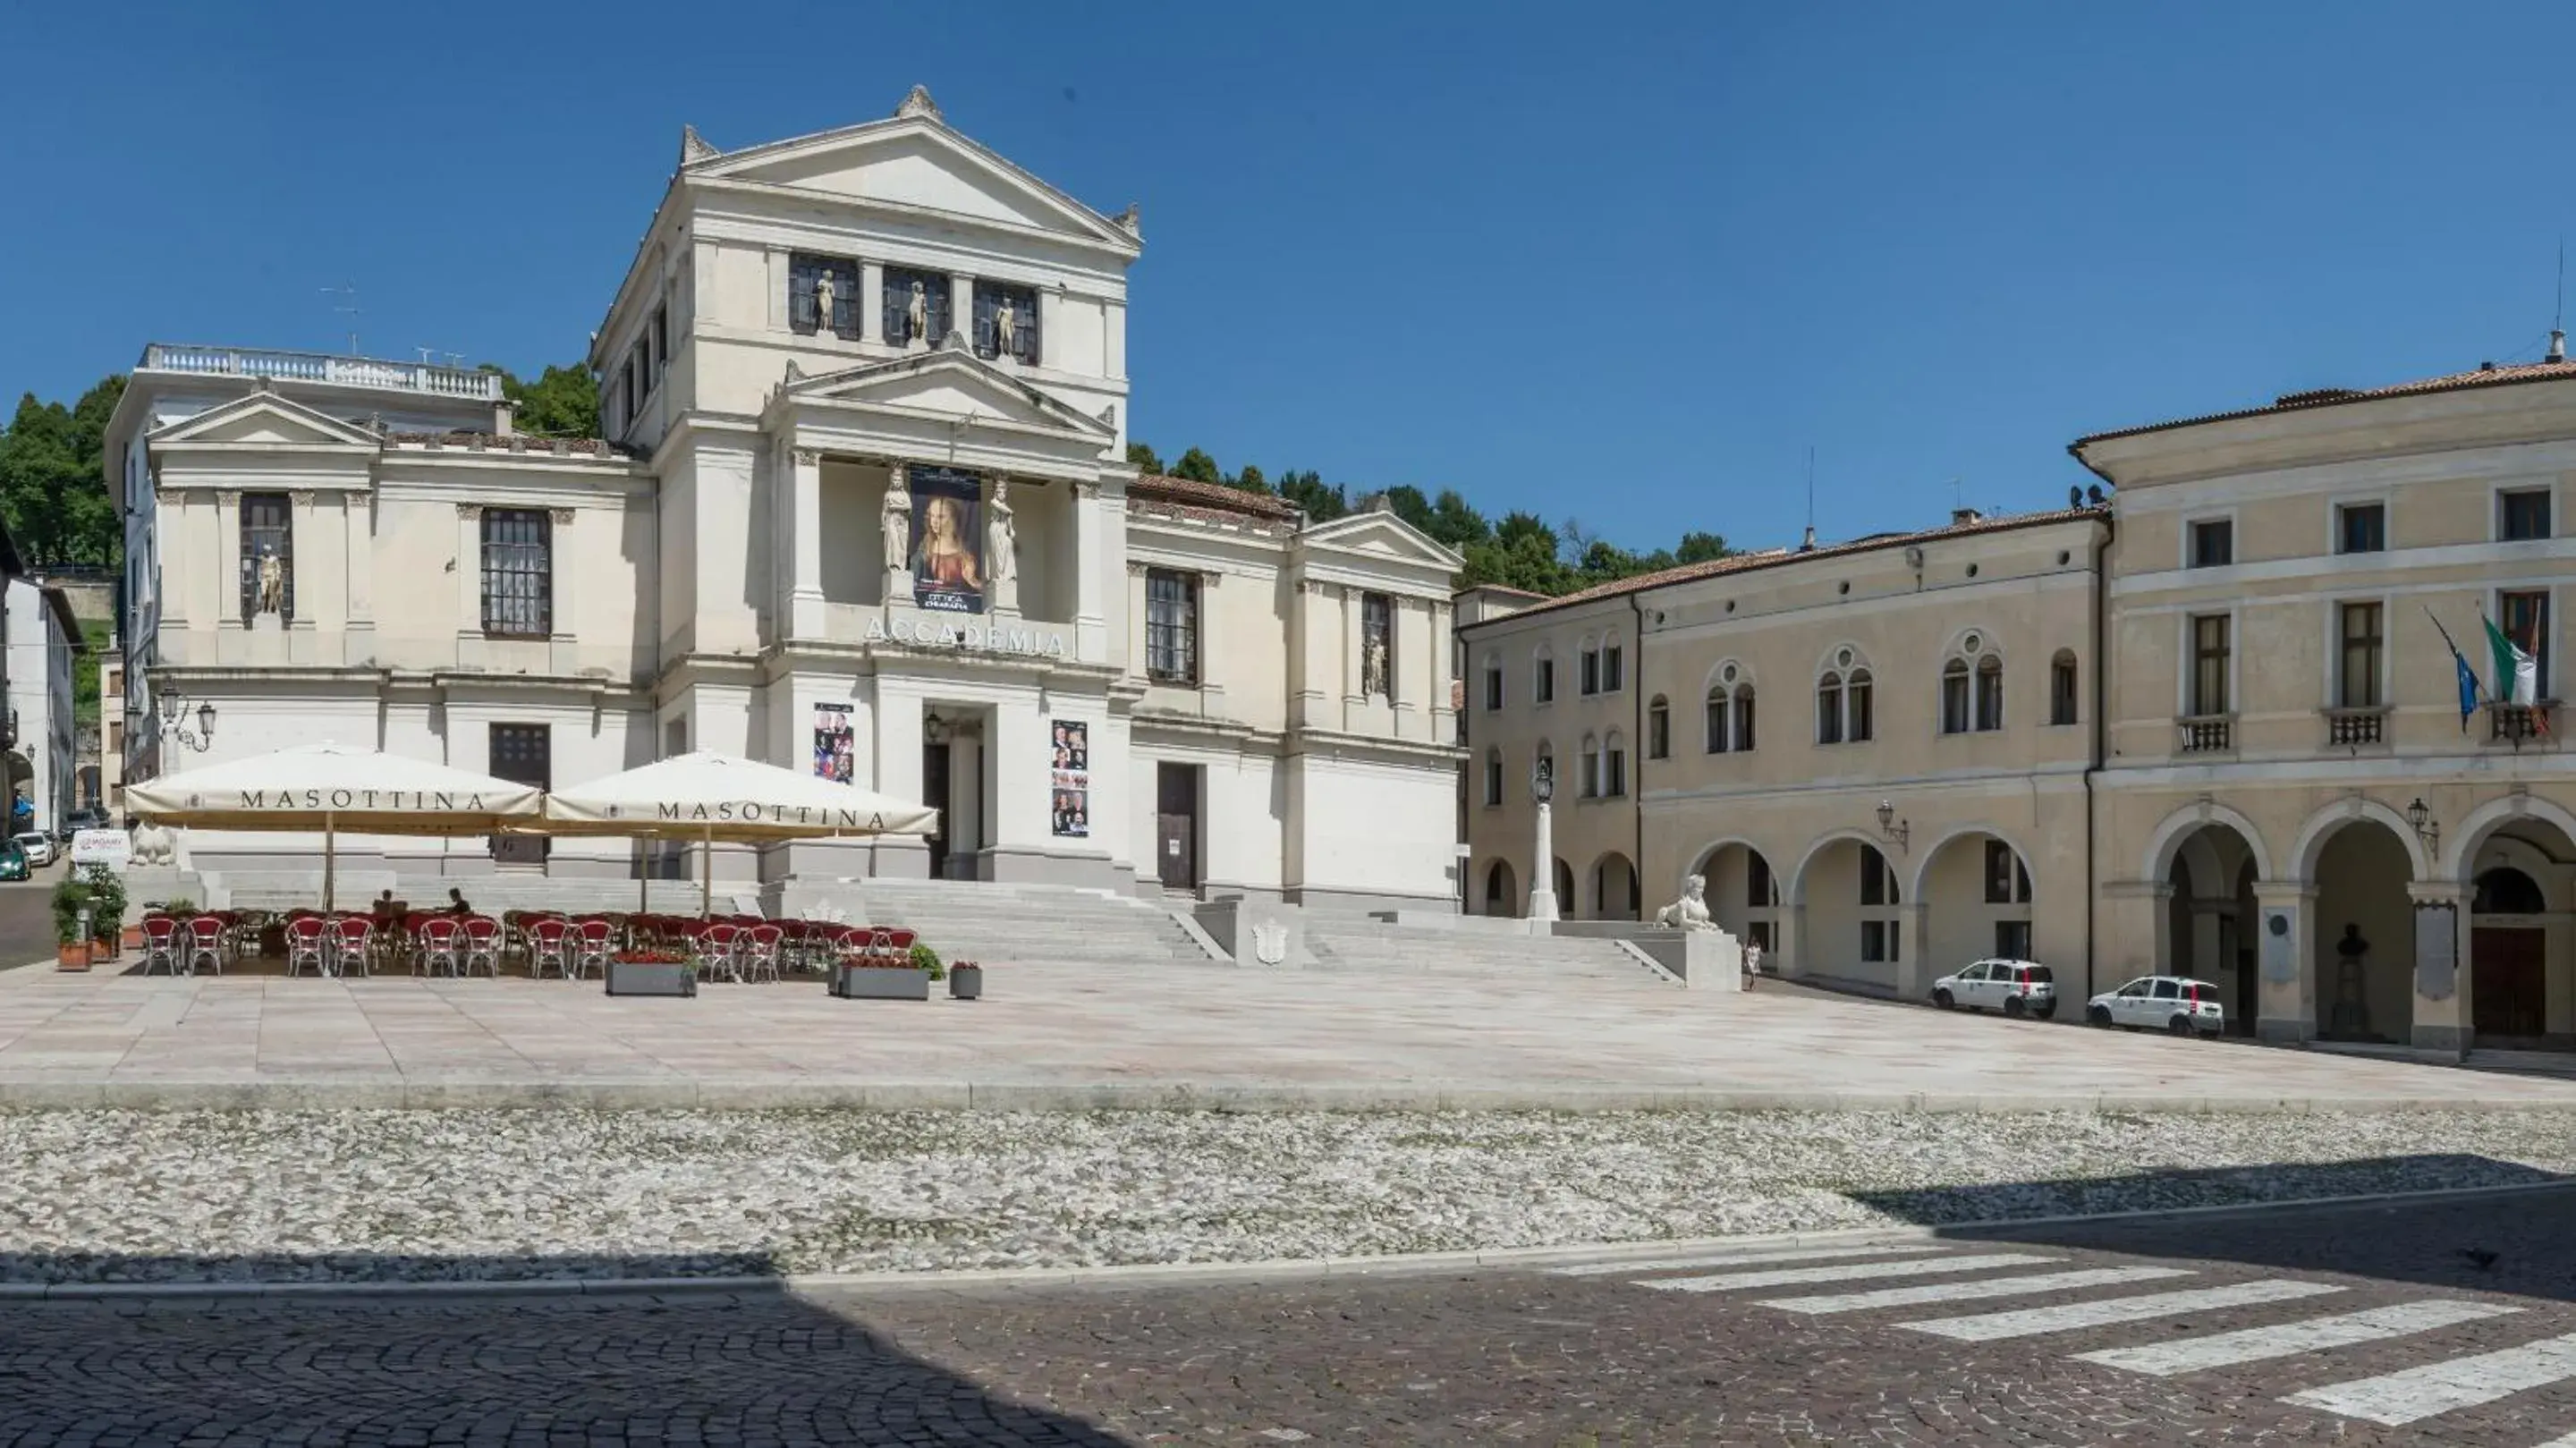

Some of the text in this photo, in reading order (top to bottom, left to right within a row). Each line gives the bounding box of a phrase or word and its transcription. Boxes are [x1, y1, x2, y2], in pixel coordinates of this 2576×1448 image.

[865, 616, 1063, 655] ACCADEMIA
[241, 790, 484, 809] MASOTTINA
[658, 801, 885, 829] MASOTTINA
